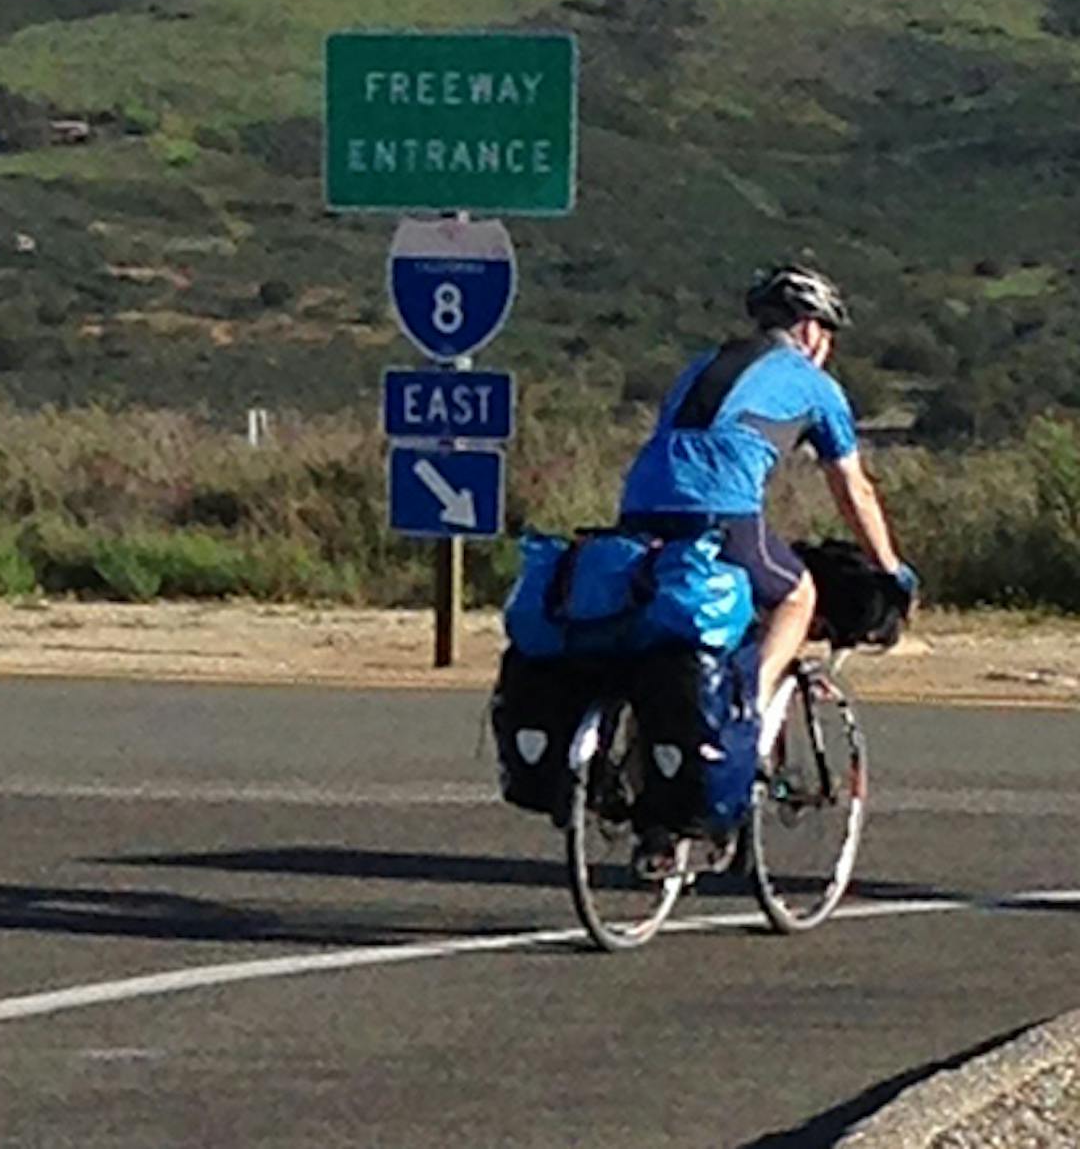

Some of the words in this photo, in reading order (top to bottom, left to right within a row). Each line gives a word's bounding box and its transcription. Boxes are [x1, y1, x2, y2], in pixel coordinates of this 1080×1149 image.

[365, 71, 545, 105] FREEWAY
[347, 139, 552, 174] ENTRANCE
[432, 283, 463, 333] 8
[403, 385, 493, 424] EAST
